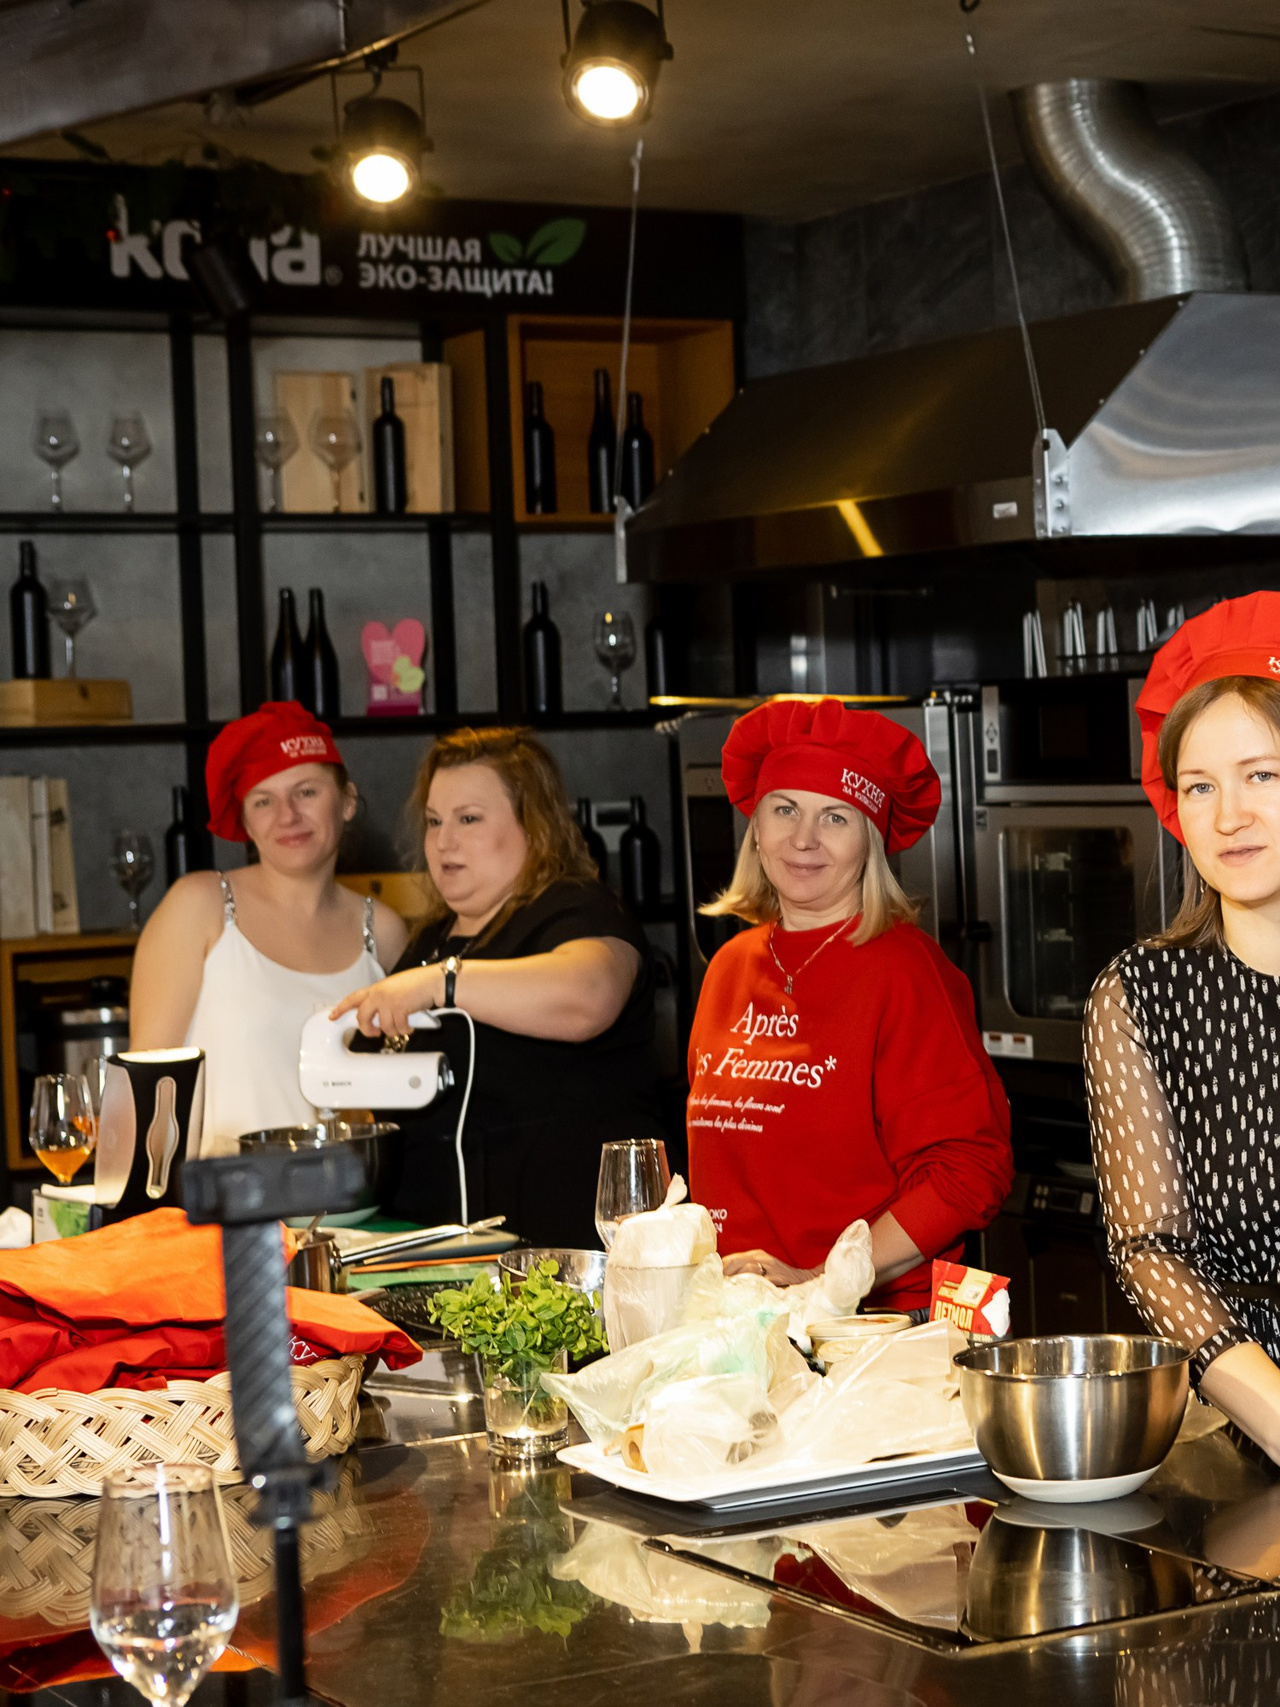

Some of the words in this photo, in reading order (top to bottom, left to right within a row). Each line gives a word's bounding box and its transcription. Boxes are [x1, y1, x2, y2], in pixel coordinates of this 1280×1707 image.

[357, 232, 482, 264] ЛУЧШАЯ
[359, 262, 554, 298] ЭКО-ЗАЩИТА!
[841, 768, 886, 808] КУХНЯ
[730, 1001, 799, 1046] Après
